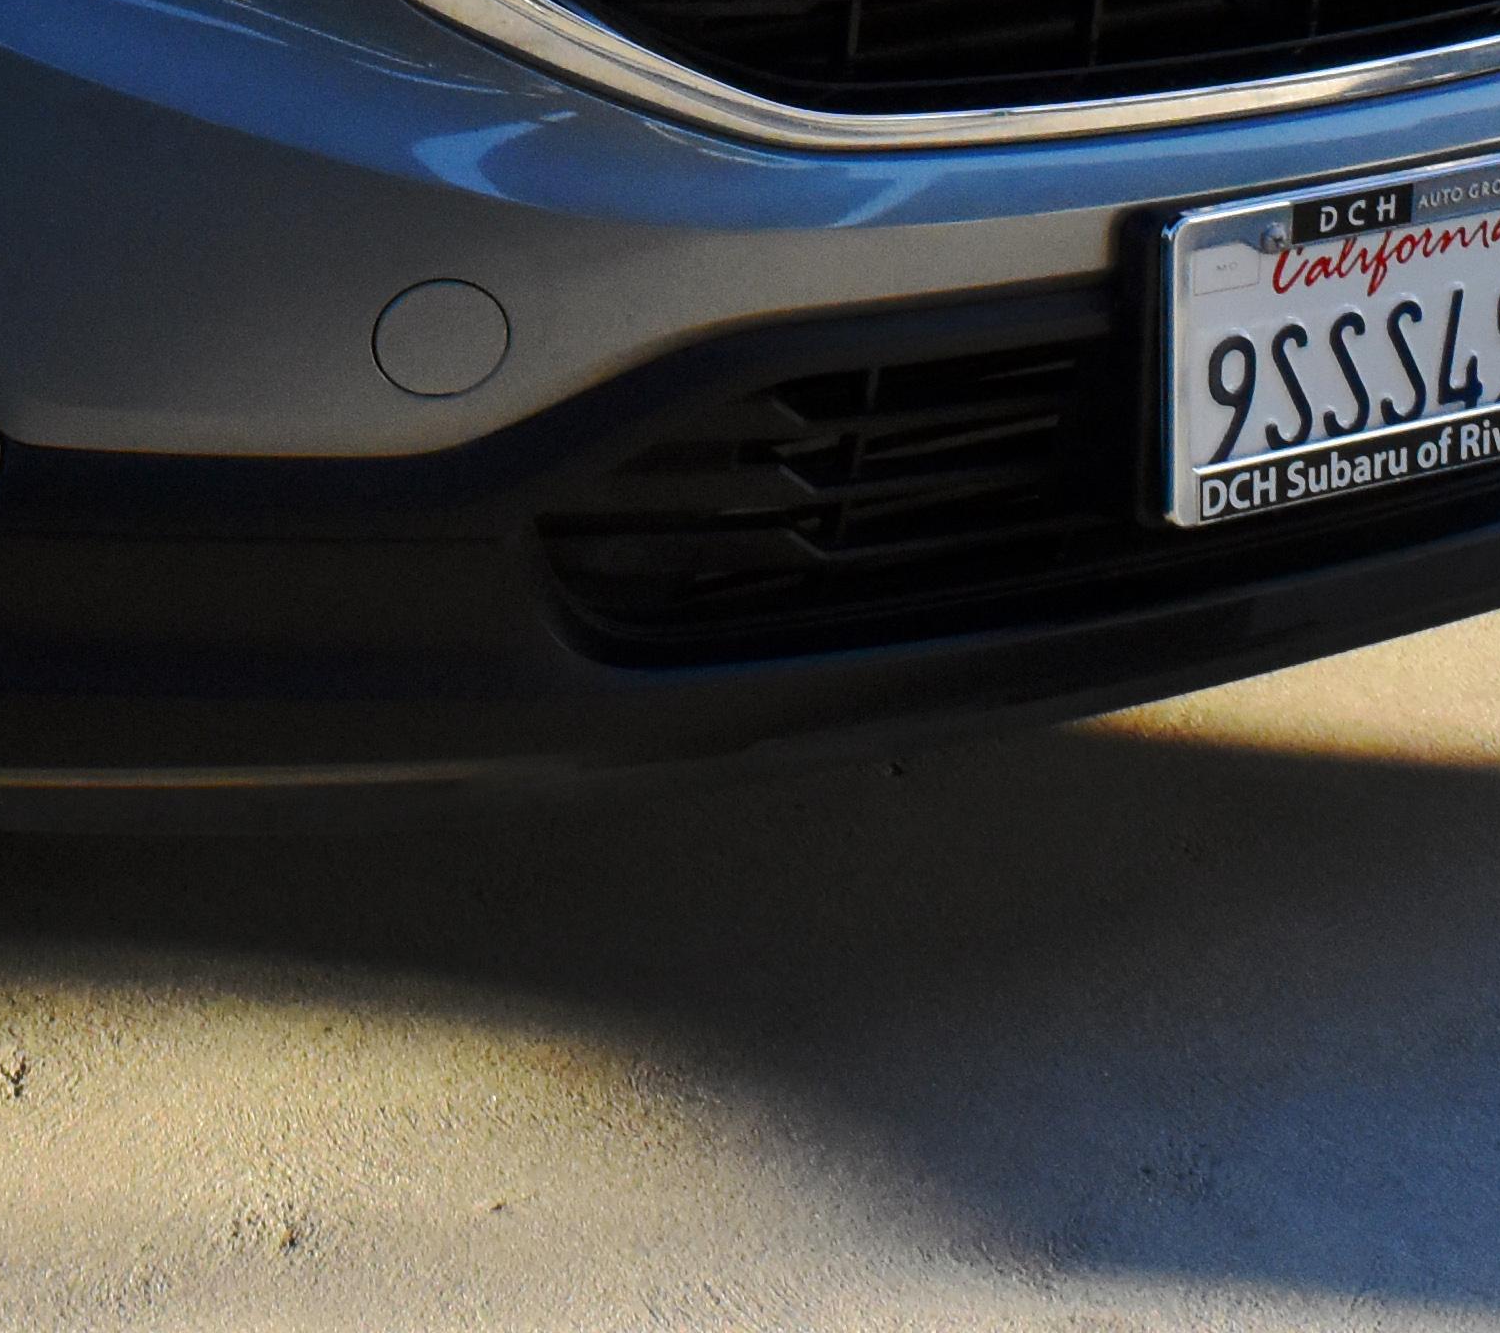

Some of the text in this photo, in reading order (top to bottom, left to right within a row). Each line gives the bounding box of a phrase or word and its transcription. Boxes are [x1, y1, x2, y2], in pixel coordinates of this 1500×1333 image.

[1319, 194, 1398, 233] DCH
[1418, 184, 1463, 210] AUTO
[1201, 464, 1278, 517] DCH
[1286, 443, 1409, 499] Subaru
[1417, 430, 1452, 469] of
